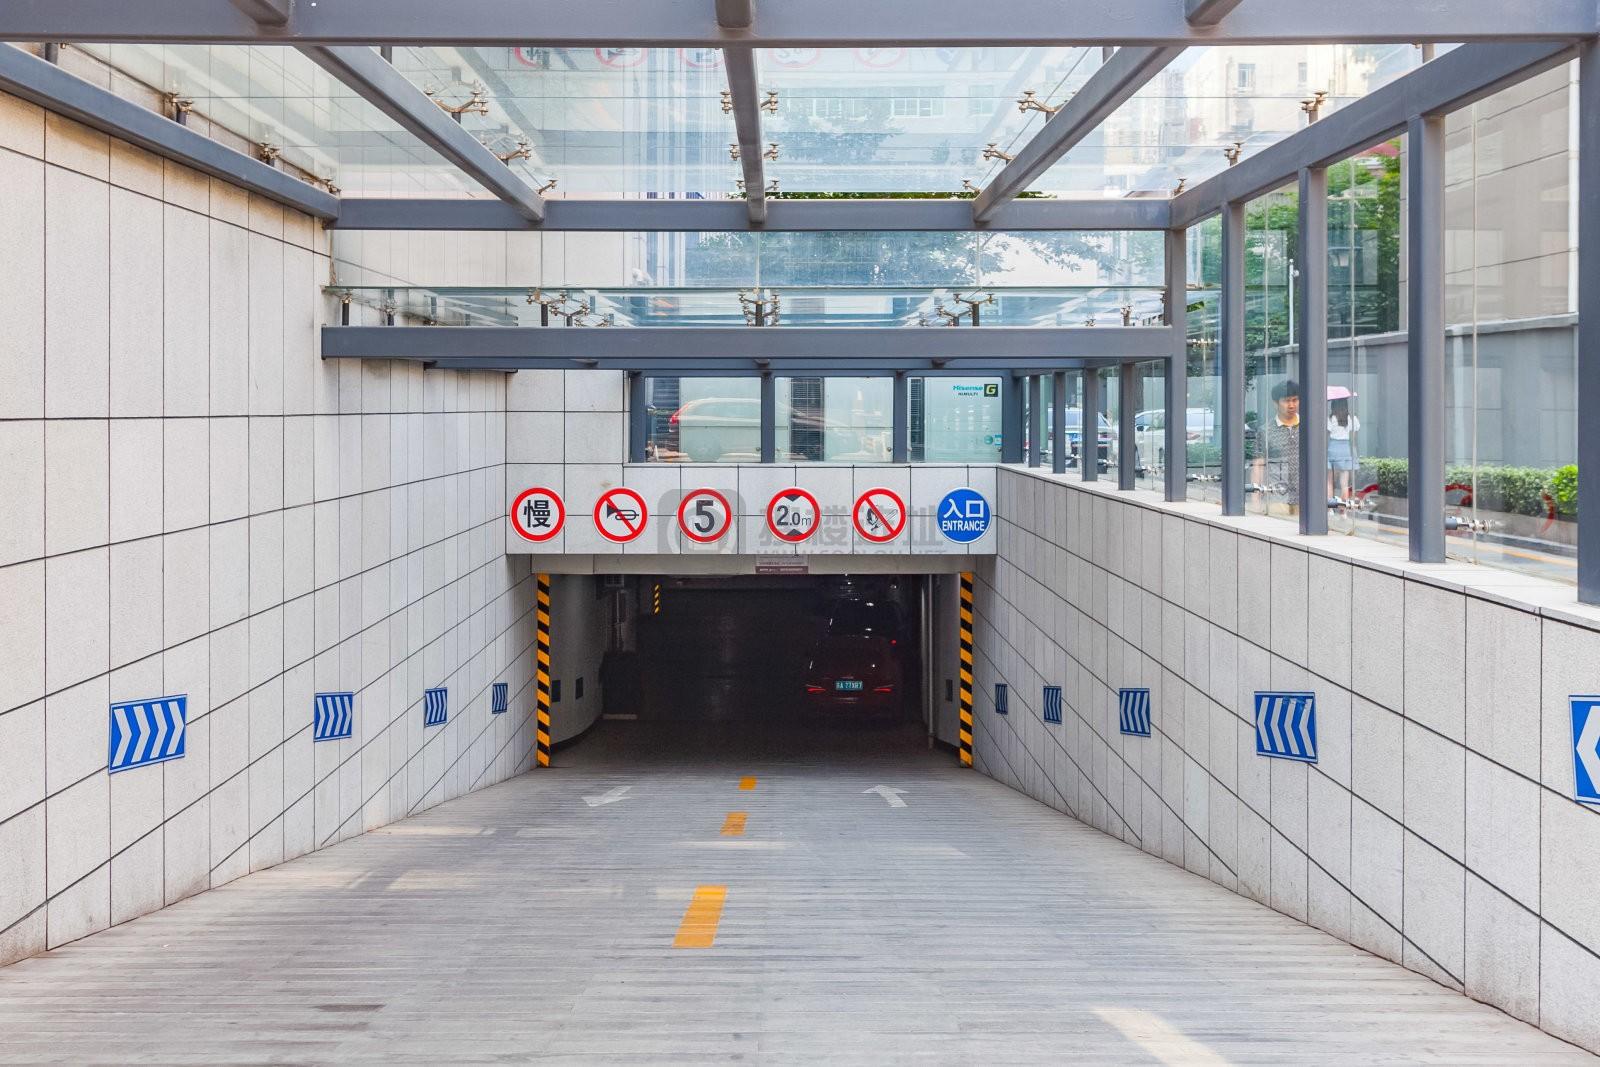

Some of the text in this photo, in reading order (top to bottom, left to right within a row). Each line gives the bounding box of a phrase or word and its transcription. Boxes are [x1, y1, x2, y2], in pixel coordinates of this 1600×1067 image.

[523, 499, 551, 528] 慢
[694, 499, 715, 533] 5
[943, 498, 985, 519] 入口
[942, 519, 985, 532] ENTRANCE
